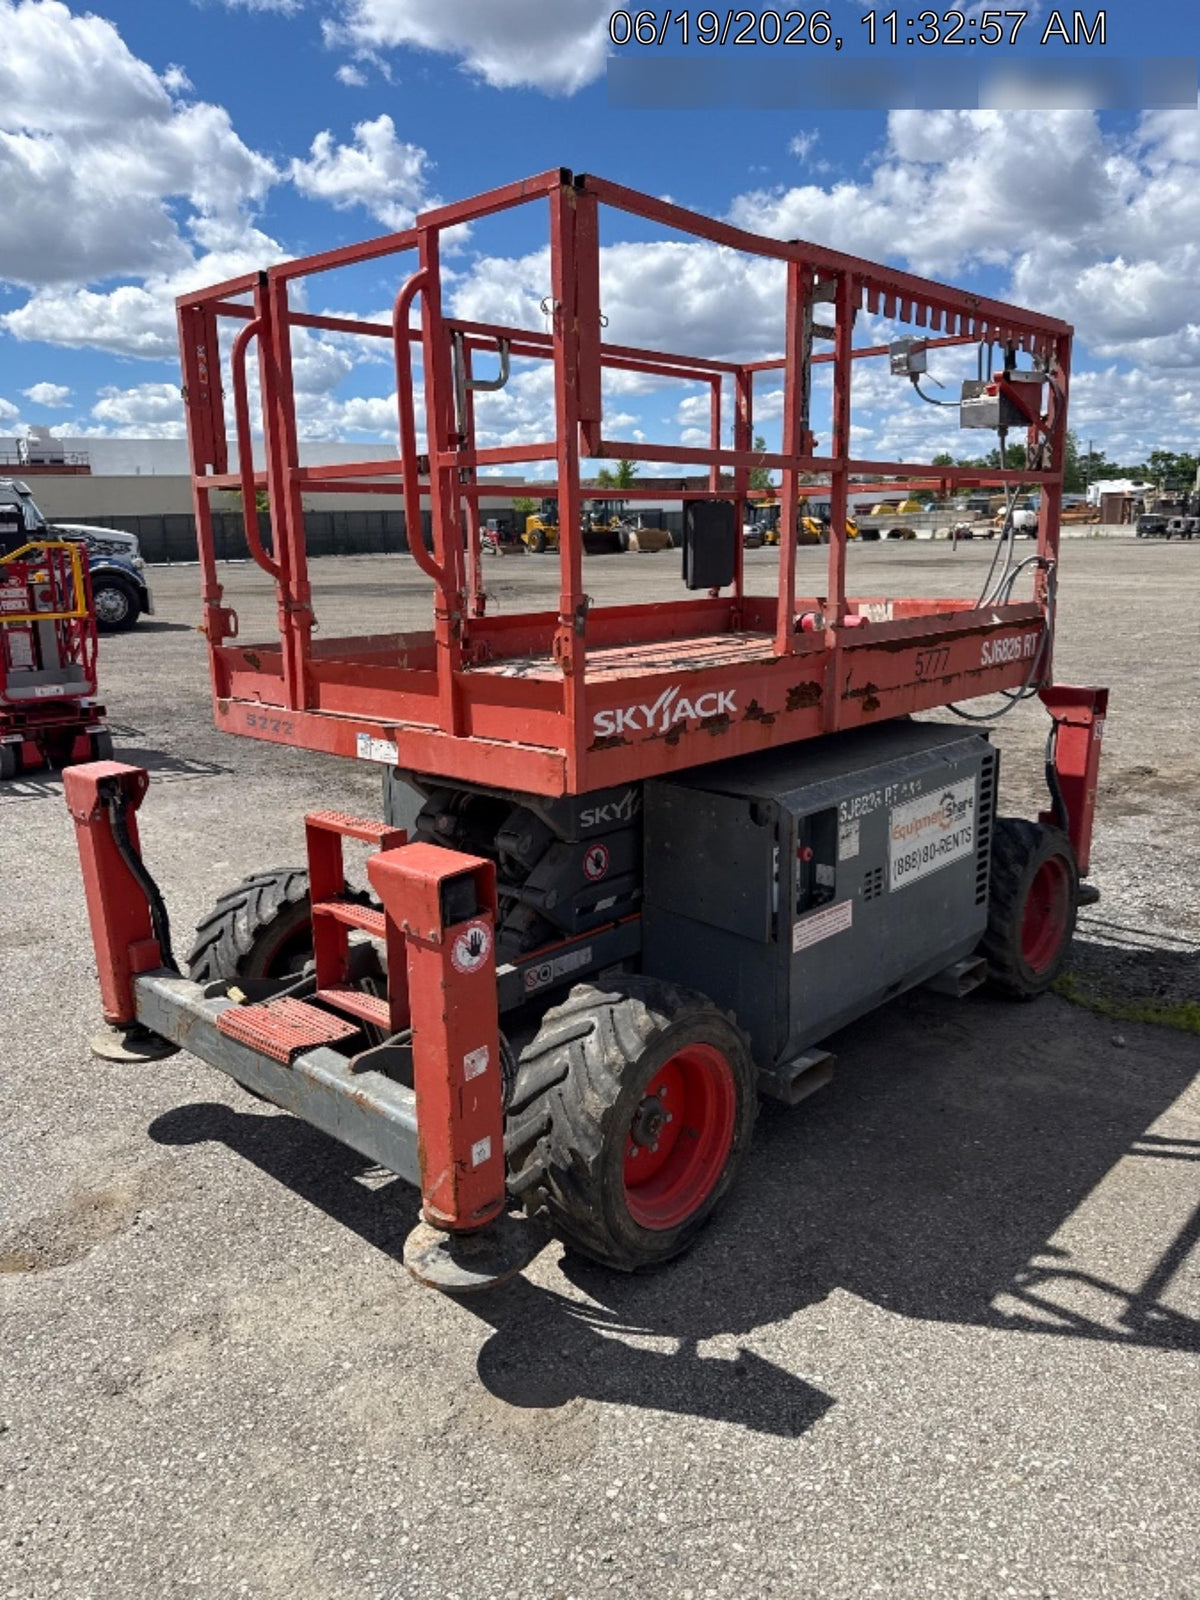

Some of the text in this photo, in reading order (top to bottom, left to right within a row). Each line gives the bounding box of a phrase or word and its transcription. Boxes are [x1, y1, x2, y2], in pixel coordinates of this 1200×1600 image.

[915, 647, 950, 676] 5777
[980, 633, 1038, 665] SJ6826 RT
[593, 684, 738, 737] SKYJACK
